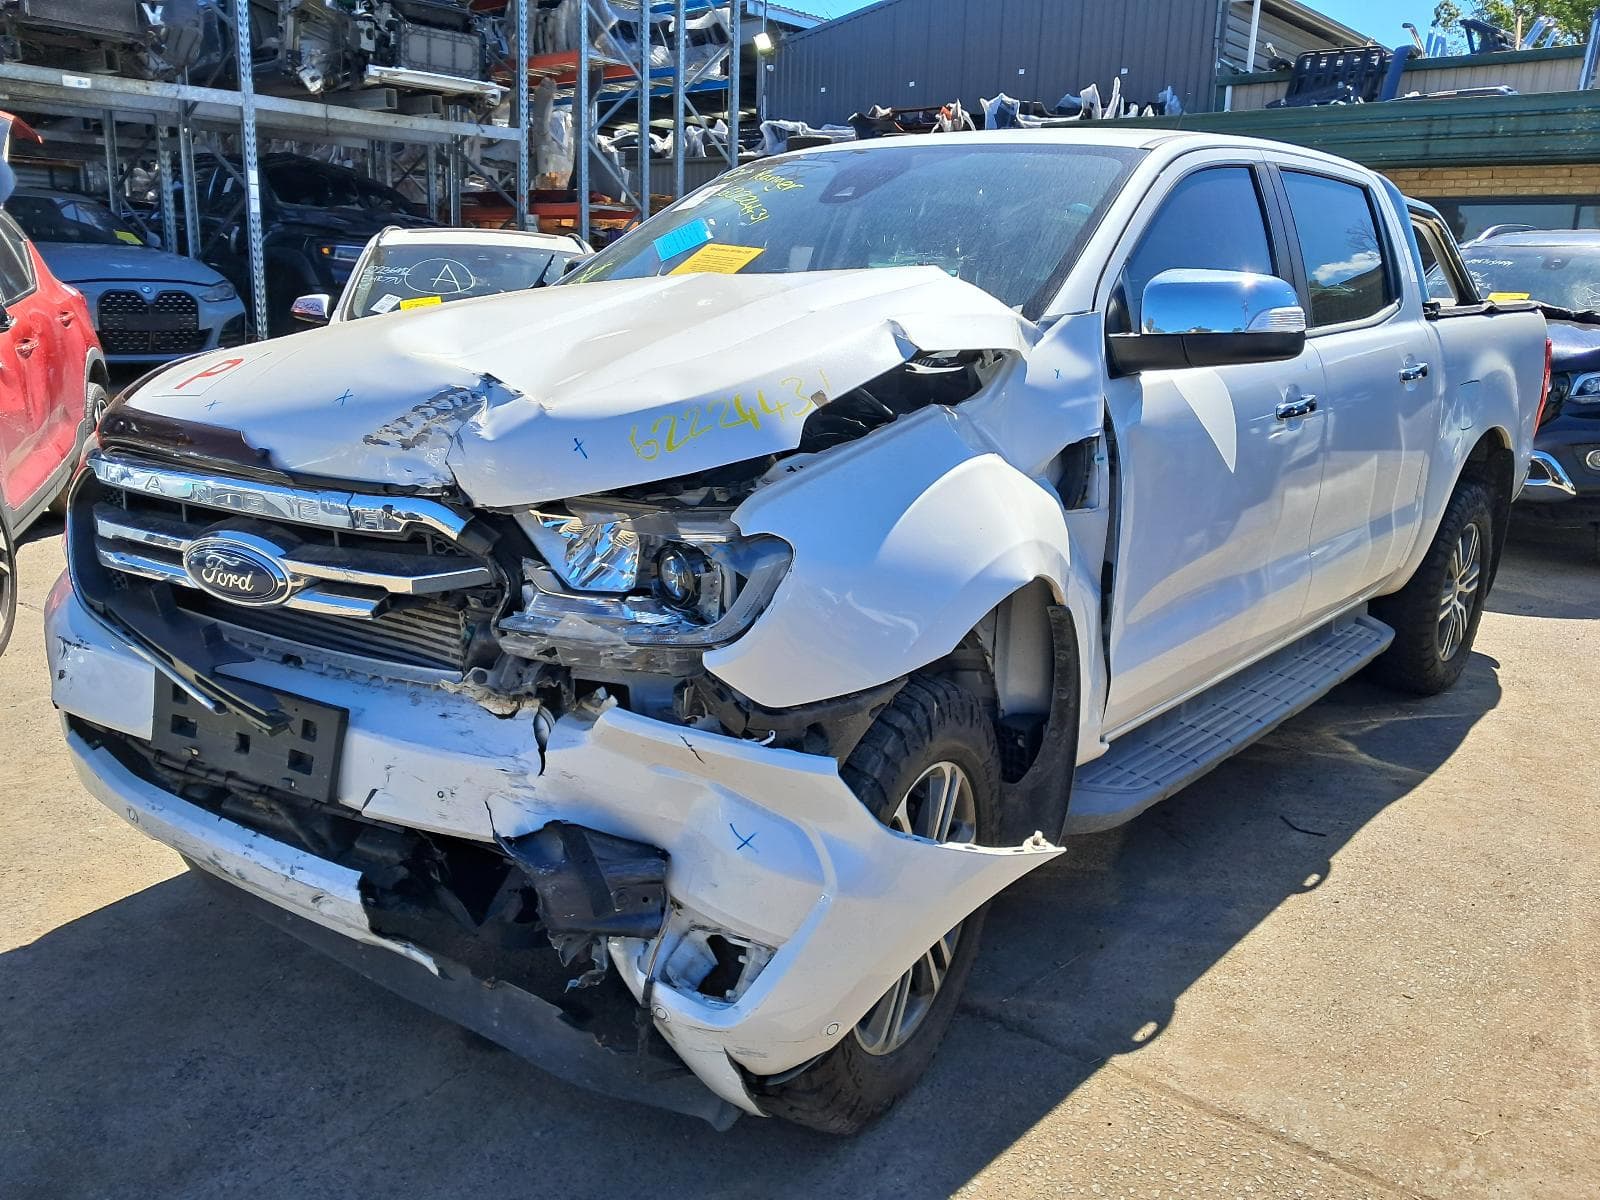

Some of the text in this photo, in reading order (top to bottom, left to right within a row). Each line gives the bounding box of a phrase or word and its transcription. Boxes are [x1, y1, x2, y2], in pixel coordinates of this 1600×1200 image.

[430, 264, 461, 292] A
[173, 358, 244, 390] P
[629, 368, 834, 461] 62224431
[201, 554, 255, 592] Ford
